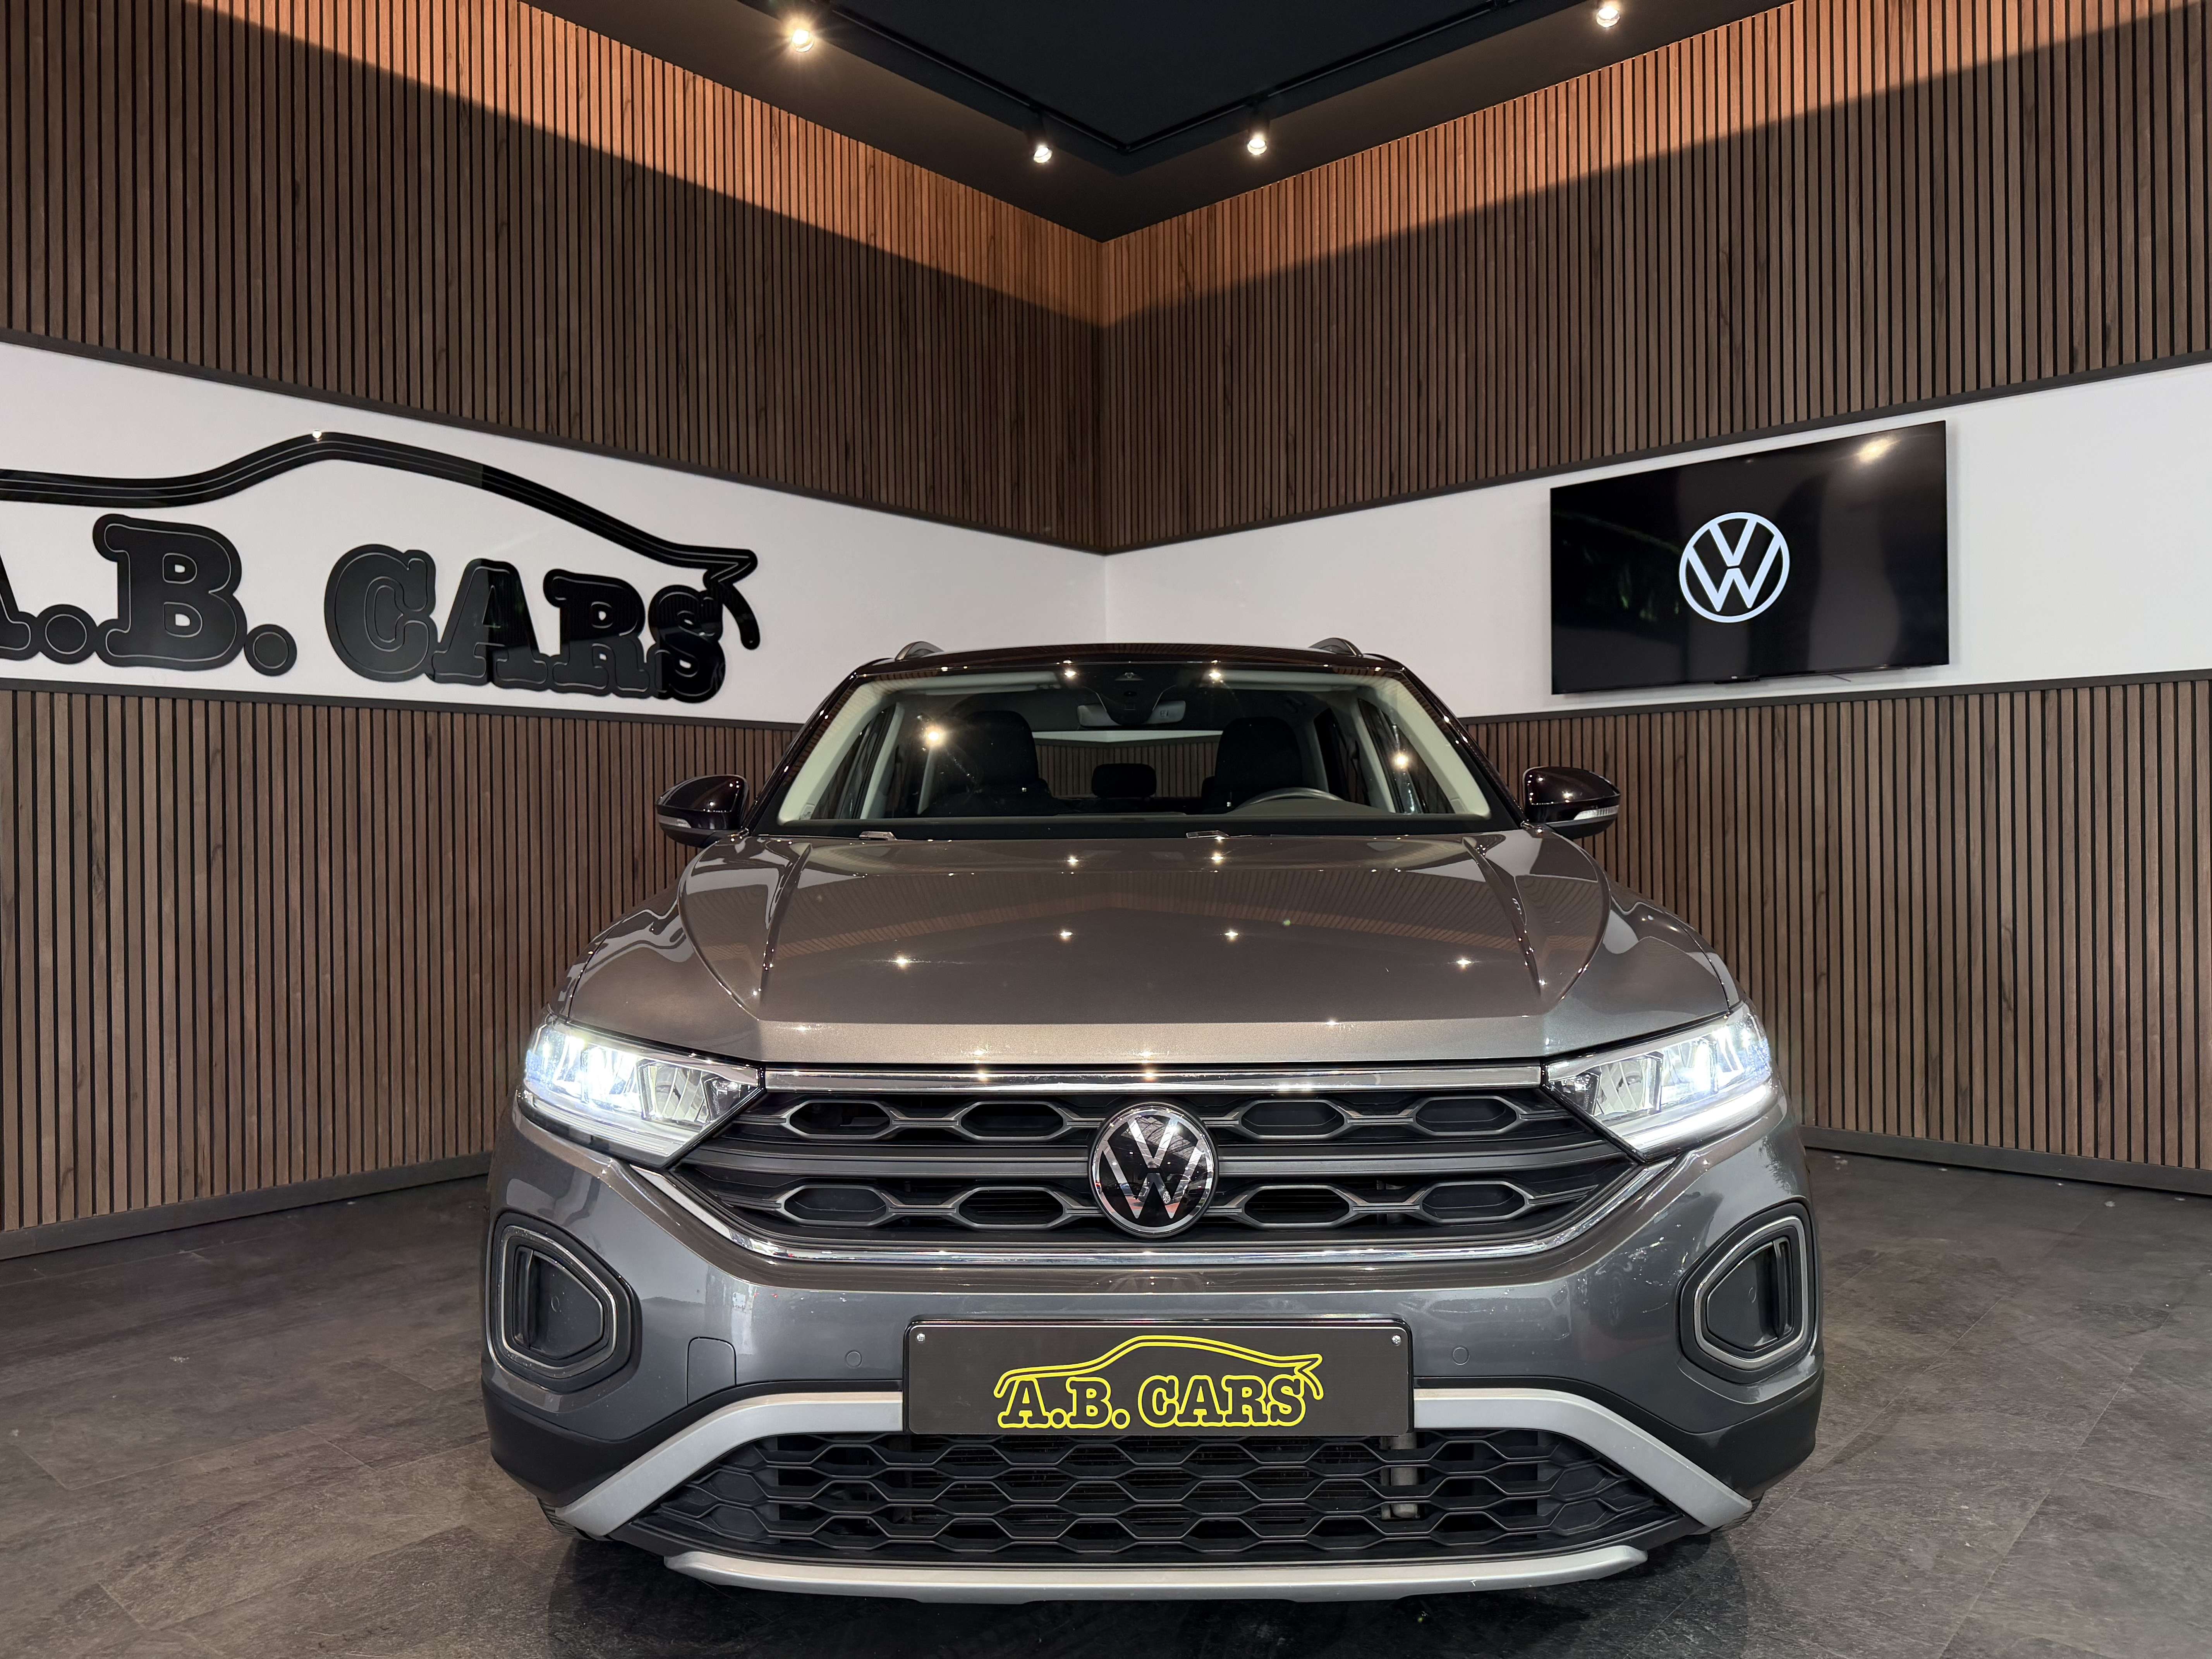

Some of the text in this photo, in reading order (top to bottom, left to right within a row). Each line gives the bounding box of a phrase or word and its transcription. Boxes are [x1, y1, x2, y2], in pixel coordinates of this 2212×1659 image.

[0, 514, 725, 702] .B. CARS
[1683, 514, 1786, 617] VW
[1099, 1111, 1208, 1223] VW
[997, 1374, 1306, 1429] A.B. CARS
